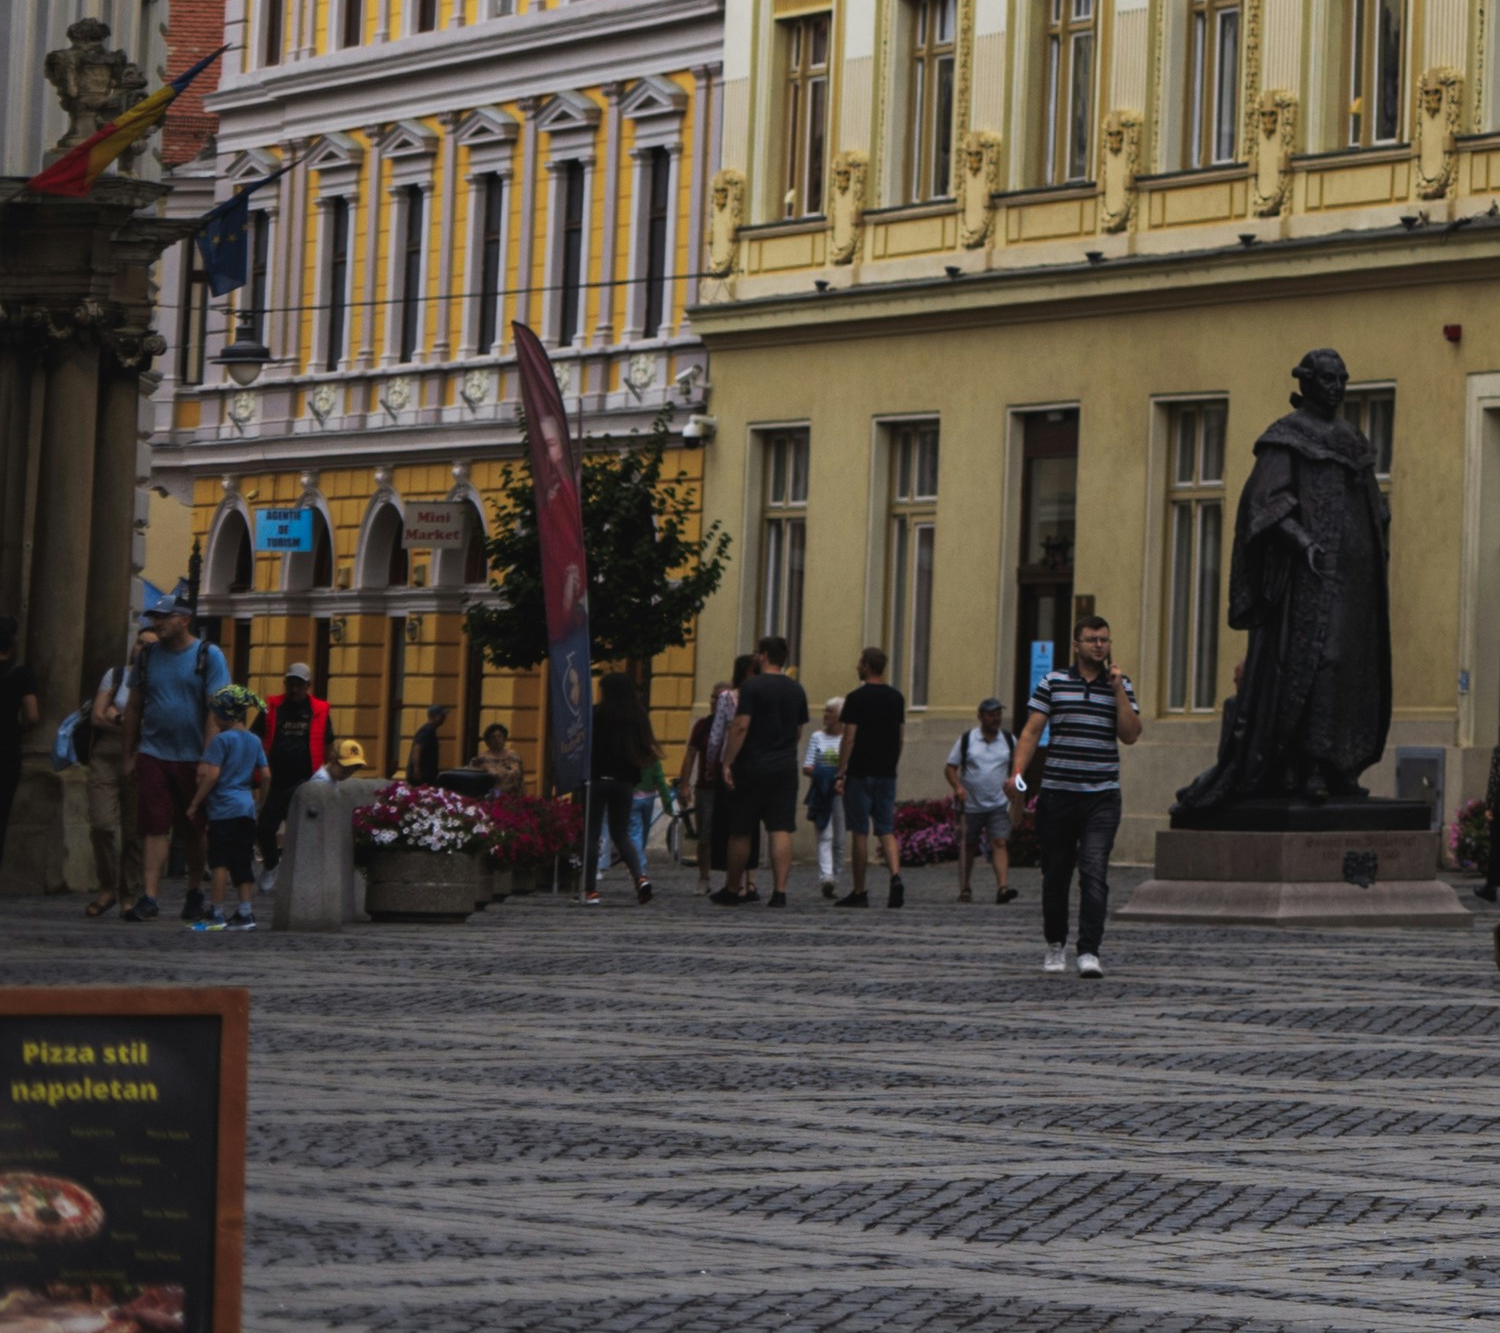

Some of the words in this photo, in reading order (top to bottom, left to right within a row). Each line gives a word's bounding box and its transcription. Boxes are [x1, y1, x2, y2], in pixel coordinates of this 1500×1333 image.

[417, 511, 451, 523] Mini
[278, 525, 289, 534] DE
[405, 529, 459, 541] Market
[267, 538, 300, 547] TURISM
[23, 1041, 95, 1064] Pizza
[103, 1041, 147, 1064] stil
[11, 1077, 158, 1107] napoletan
